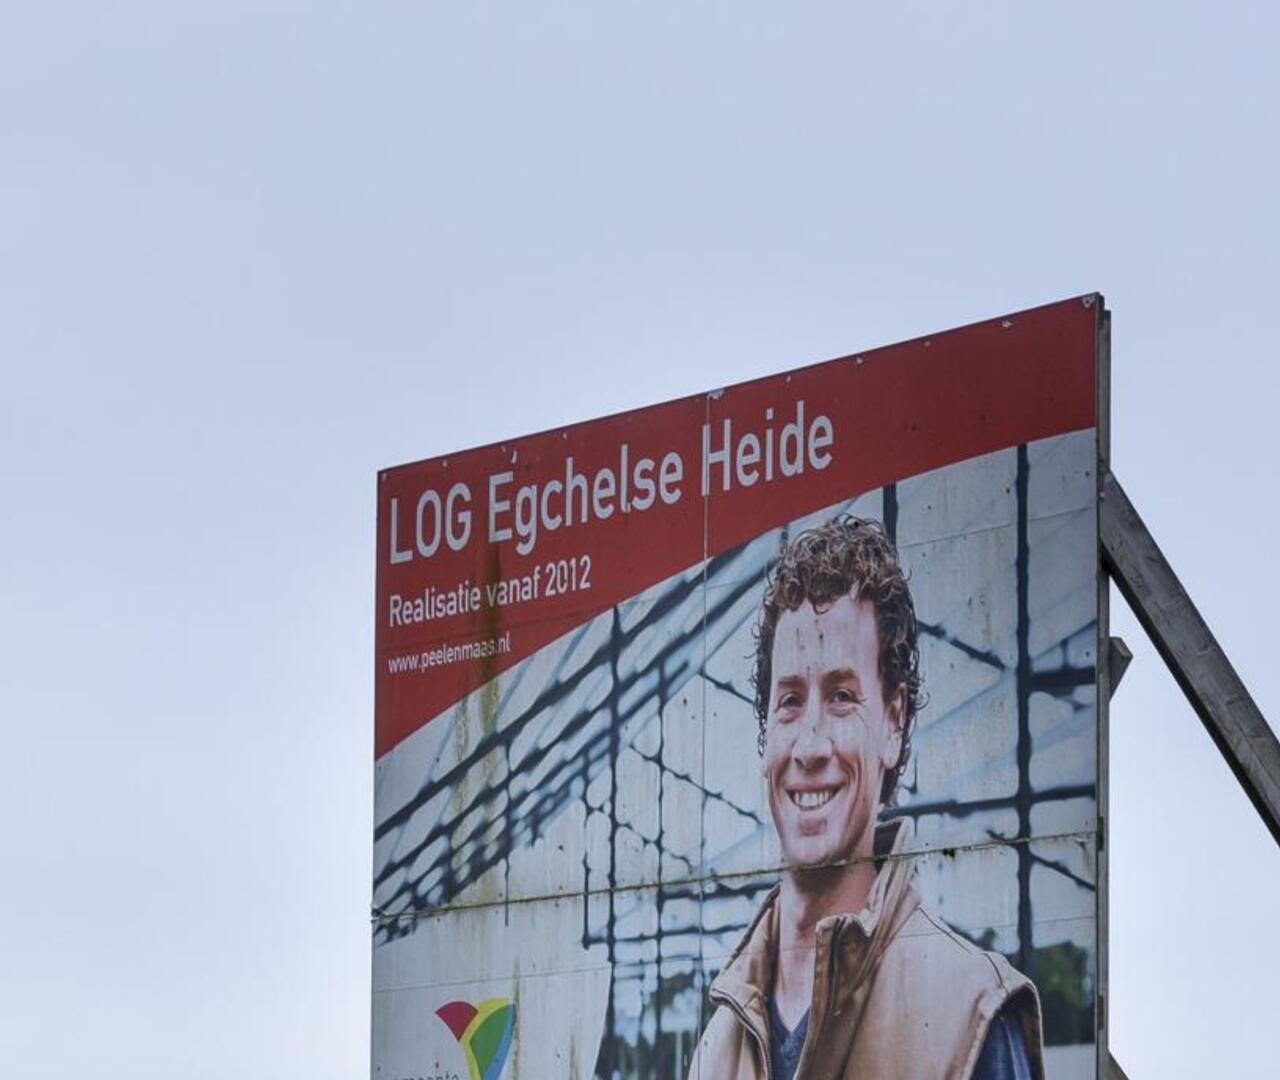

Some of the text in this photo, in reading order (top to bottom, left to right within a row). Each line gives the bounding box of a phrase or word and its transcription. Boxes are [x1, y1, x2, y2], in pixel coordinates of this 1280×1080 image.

[390, 400, 834, 564] LOG Egchelse Heide
[389, 554, 591, 627] Realisatie vanaf 2012
[388, 631, 511, 674] www.peelenmaas.nl
